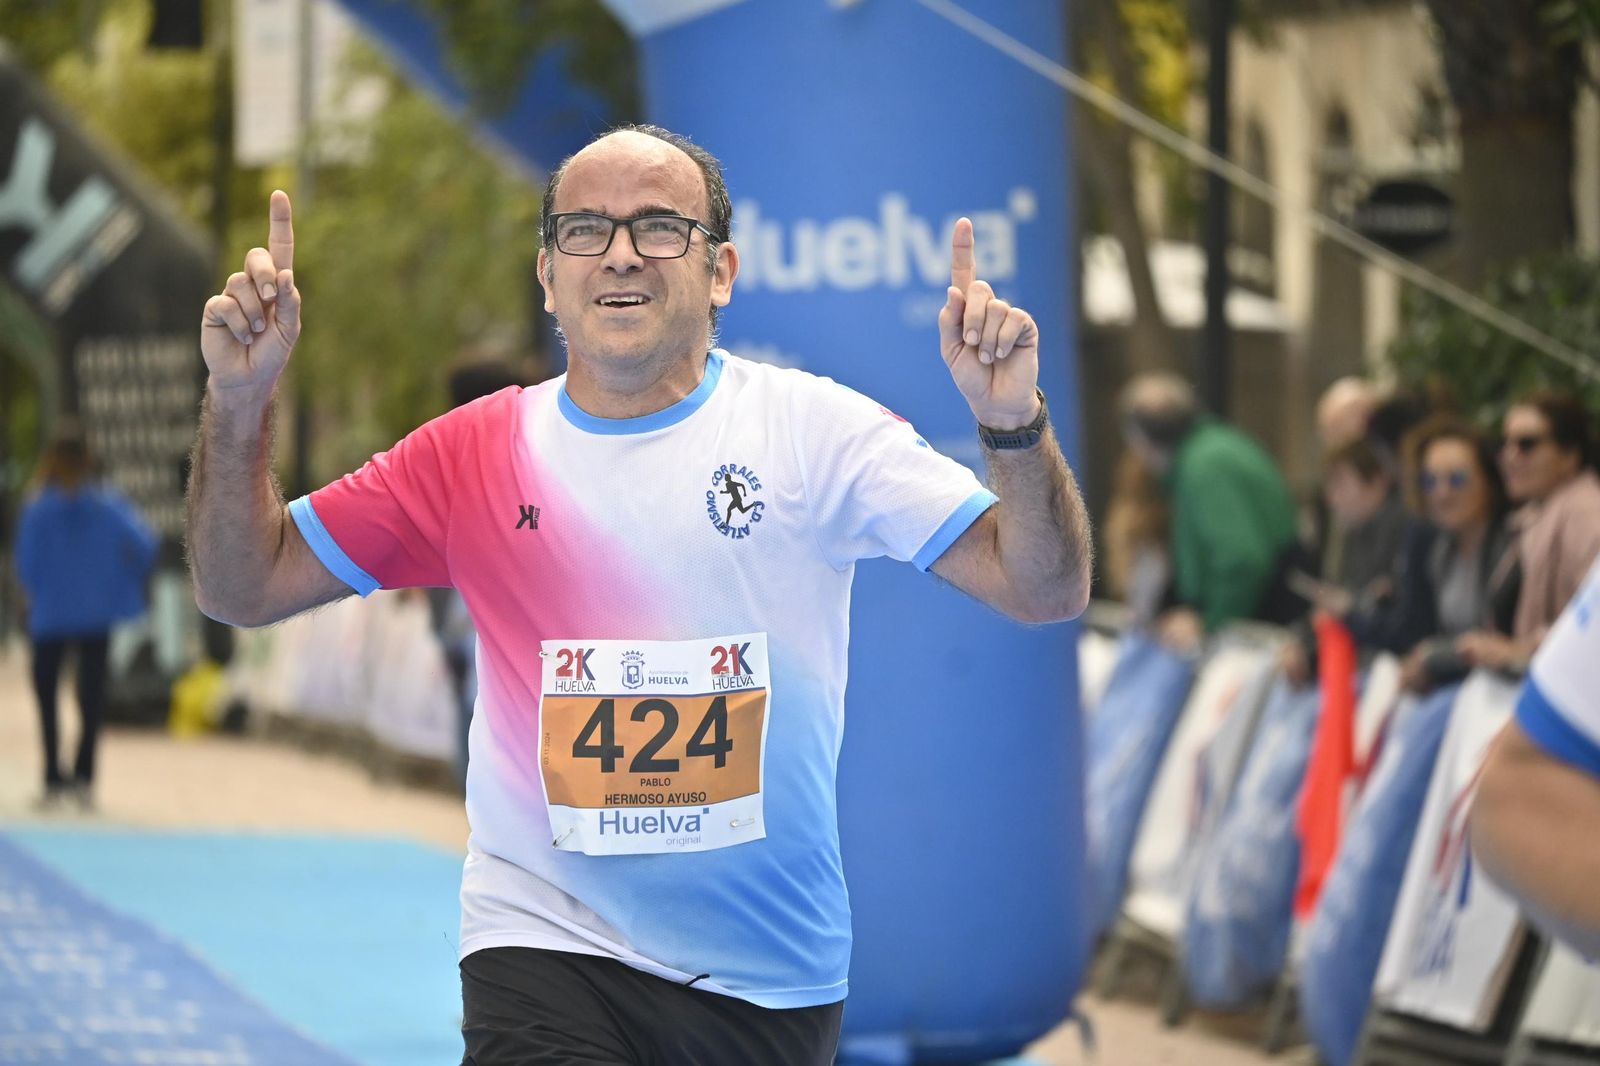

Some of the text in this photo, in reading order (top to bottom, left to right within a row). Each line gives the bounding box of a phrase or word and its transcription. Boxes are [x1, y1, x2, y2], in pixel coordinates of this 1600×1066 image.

[711, 463, 762, 492] CORRALES
[555, 647, 596, 681] 21K
[710, 641, 754, 677] 21K
[555, 680, 596, 693] HUELVA
[648, 676, 689, 685] HUELVA
[712, 675, 755, 690] HUELVA
[572, 695, 733, 773] 424
[640, 777, 671, 787] PABLO
[605, 791, 707, 805] HERMOSO AYUSO
[599, 808, 701, 835] Huelva
[666, 835, 701, 847] original
